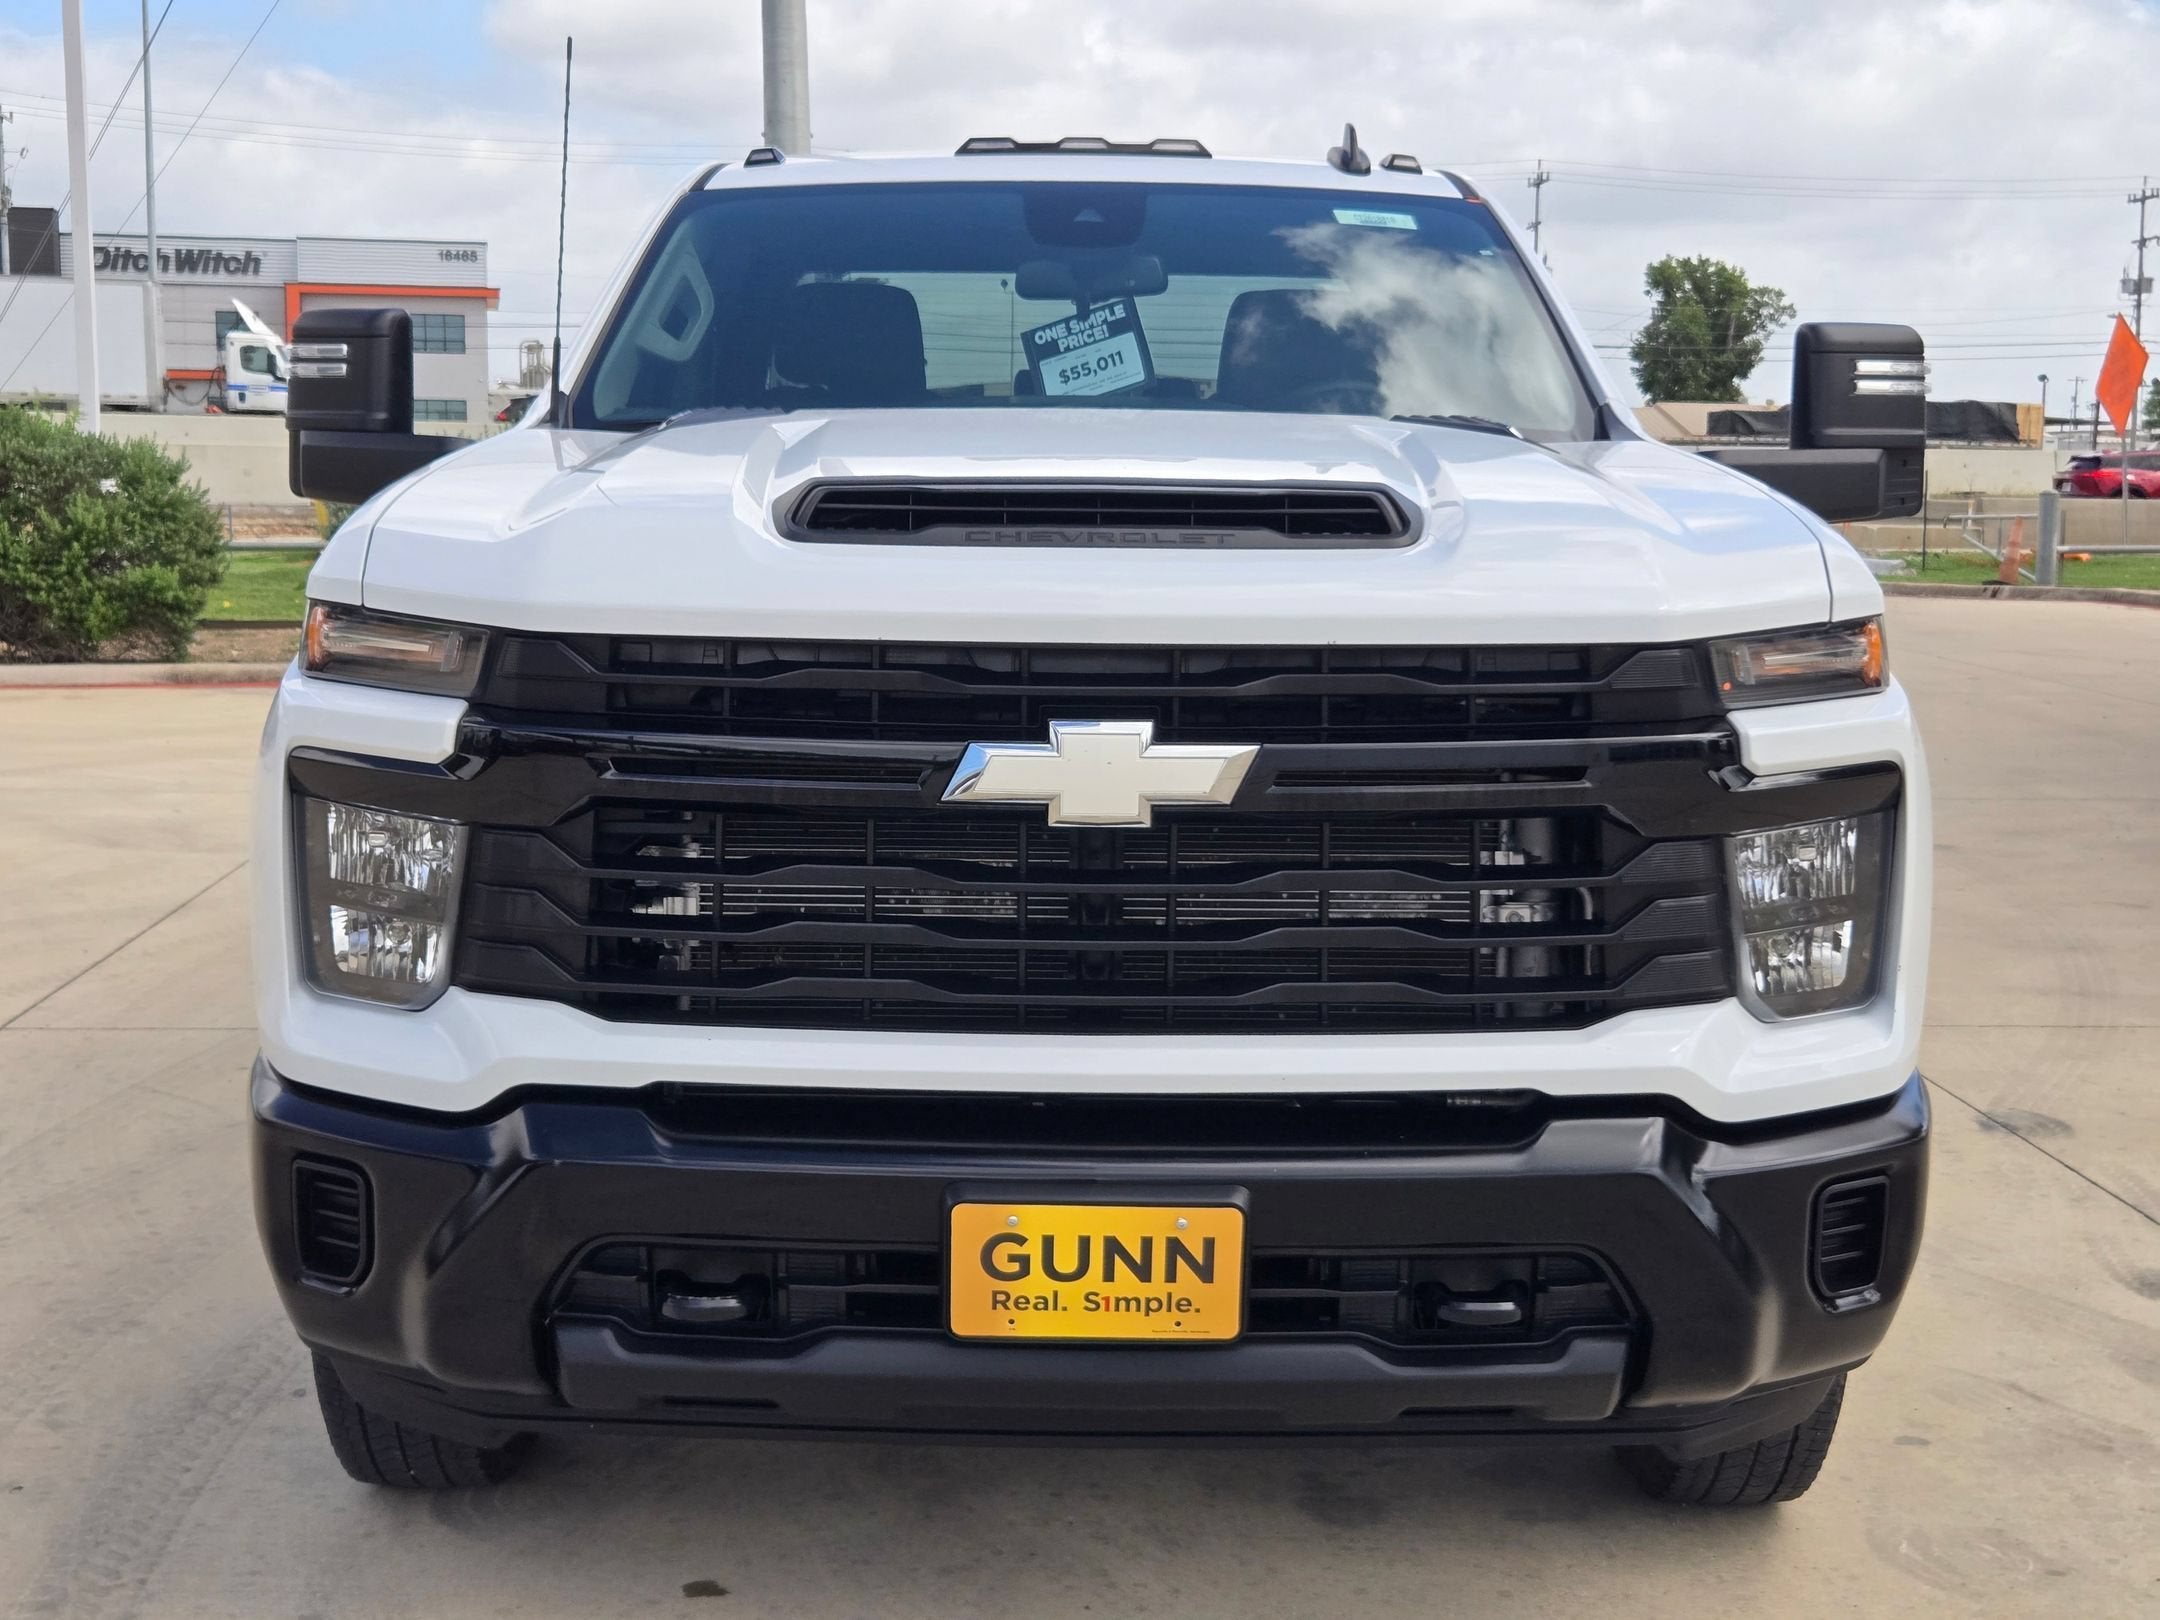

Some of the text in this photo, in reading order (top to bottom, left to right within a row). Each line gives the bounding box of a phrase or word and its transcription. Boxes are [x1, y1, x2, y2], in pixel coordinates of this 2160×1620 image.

[94, 247, 262, 275] Ditch Witch
[1035, 323, 1068, 345] ONE
[1057, 324, 1110, 352] PRICE!
[1058, 351, 1124, 386] $55,011
[964, 530, 1235, 545] CHEVROLET
[979, 1232, 1216, 1284] GUNN
[991, 1290, 1068, 1312] Real.
